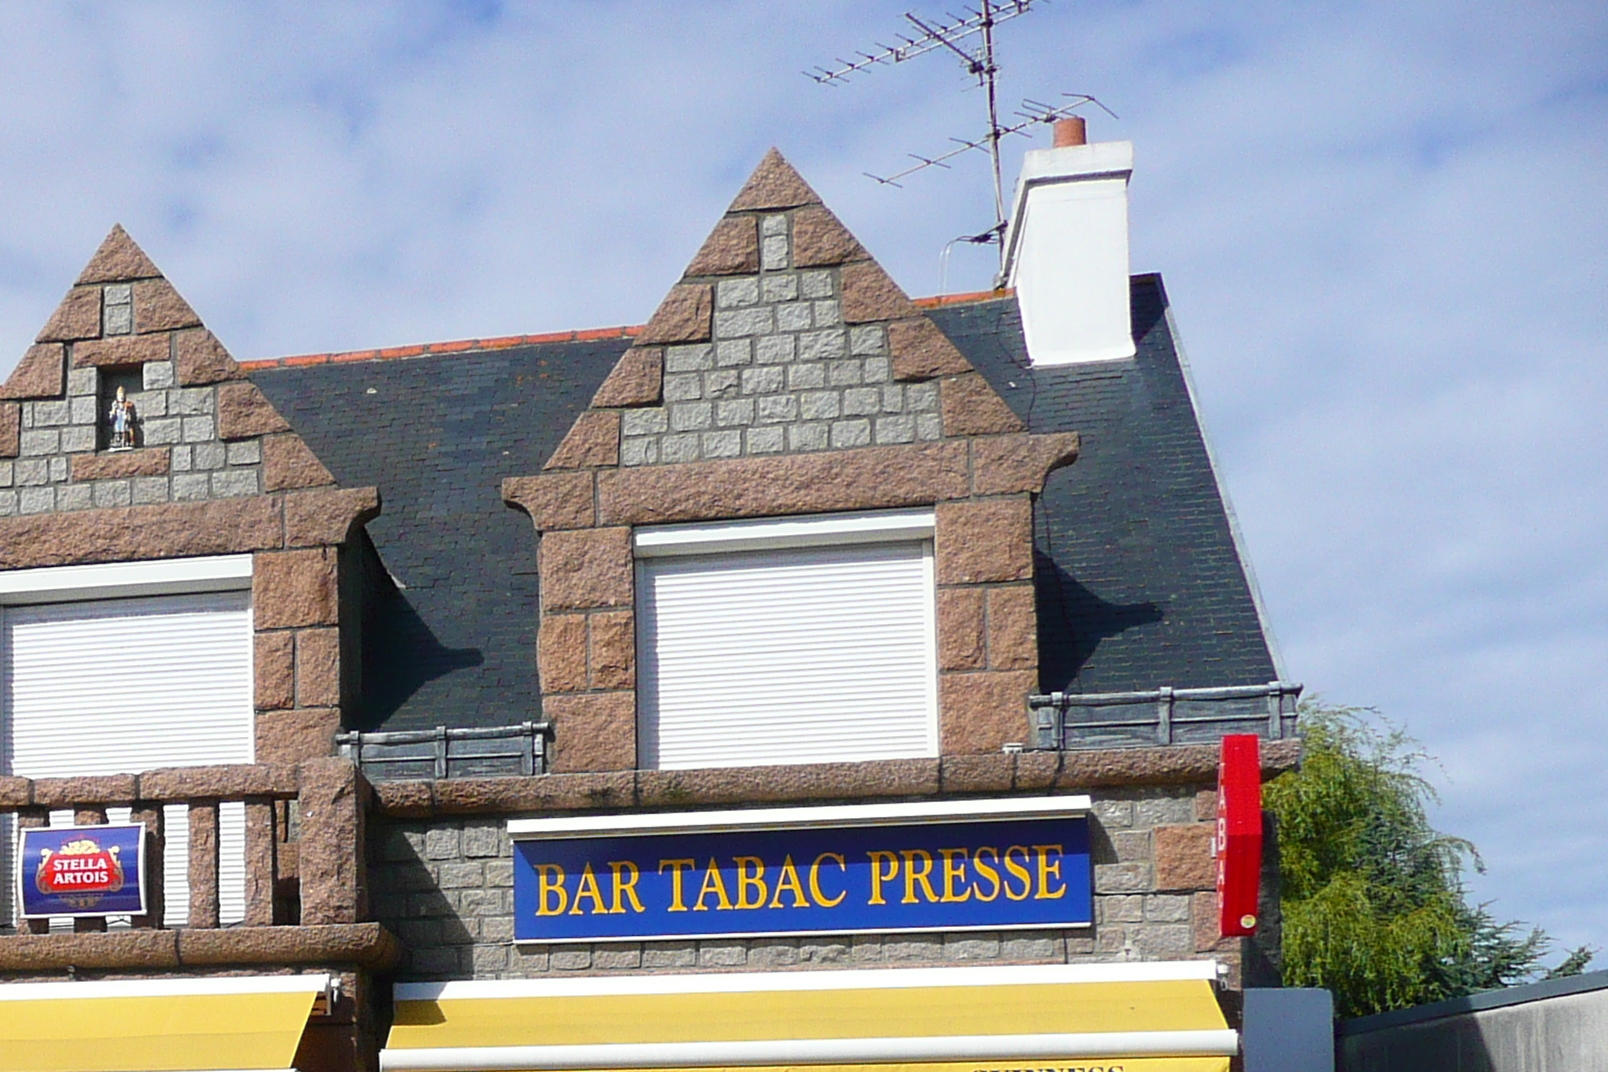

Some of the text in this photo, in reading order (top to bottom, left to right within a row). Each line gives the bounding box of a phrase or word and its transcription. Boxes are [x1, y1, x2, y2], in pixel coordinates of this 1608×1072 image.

[53, 859, 108, 871] STELLA
[53, 871, 109, 884] ARTOIS
[535, 844, 1068, 917] BAR TABAC PRESSE
